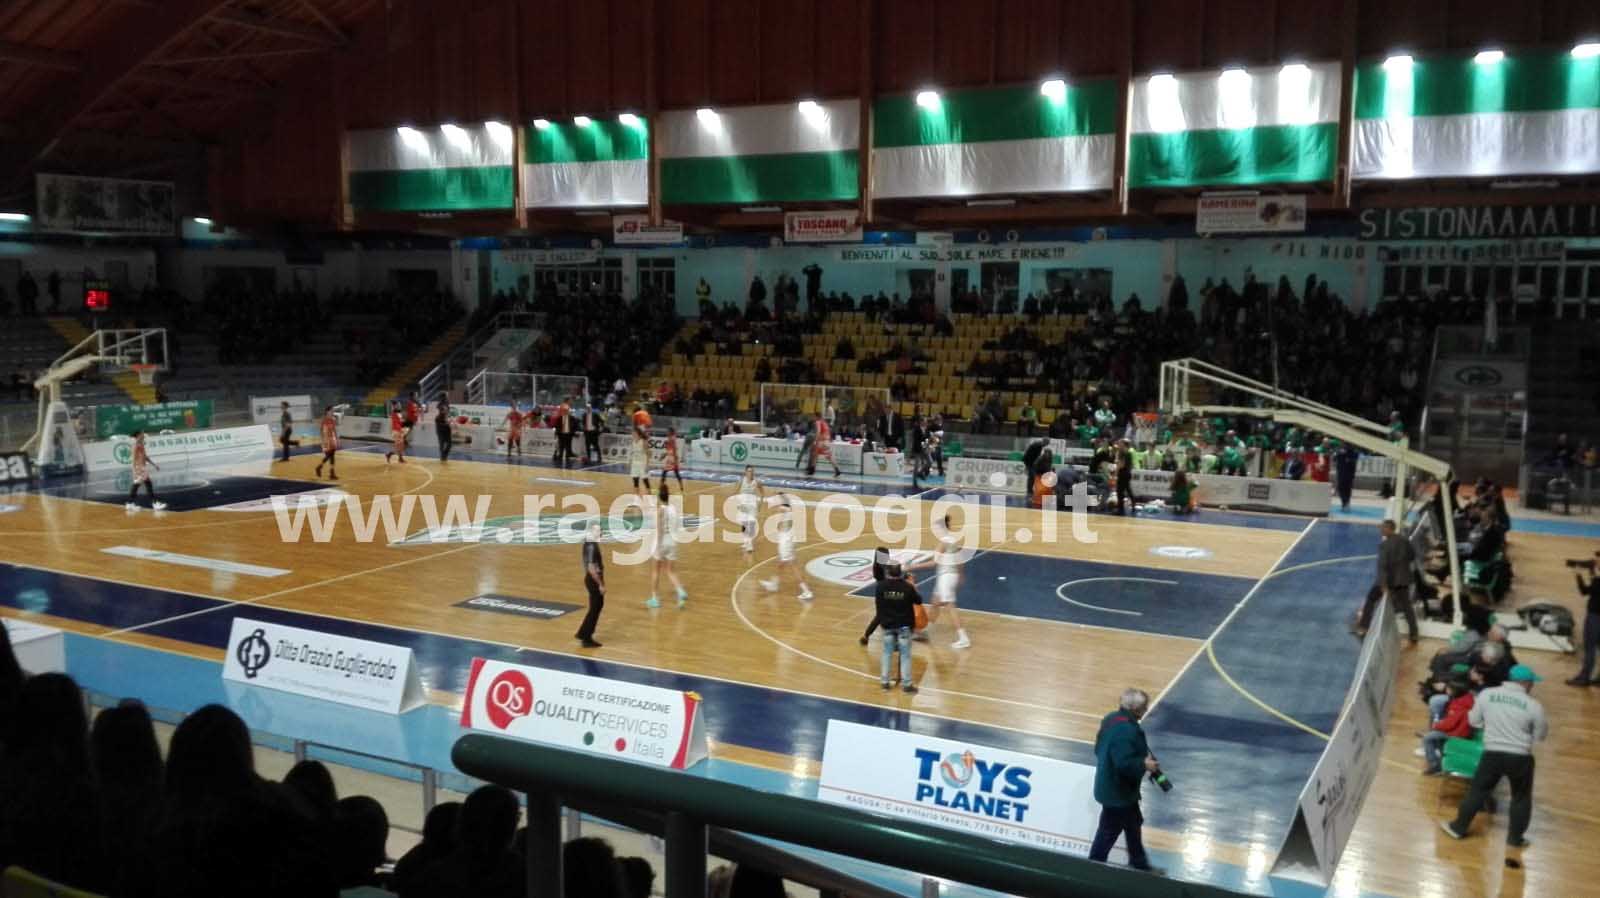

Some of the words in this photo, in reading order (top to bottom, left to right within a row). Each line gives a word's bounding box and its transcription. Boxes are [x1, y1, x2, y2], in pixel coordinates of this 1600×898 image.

[798, 218, 847, 230] TOSCANO
[841, 248, 894, 261] BENVENUTI
[750, 442, 800, 453] Passala
[274, 639, 300, 662] Ditta
[299, 644, 333, 668] Orazio
[333, 650, 397, 680] Gugliandolo
[562, 686, 585, 699] ENTE
[586, 690, 596, 701] DI
[596, 692, 672, 715] CERTIFICAZIONE
[631, 737, 665, 759] Italia
[914, 747, 1033, 800] TOYS
[914, 783, 1030, 824] PLANET
